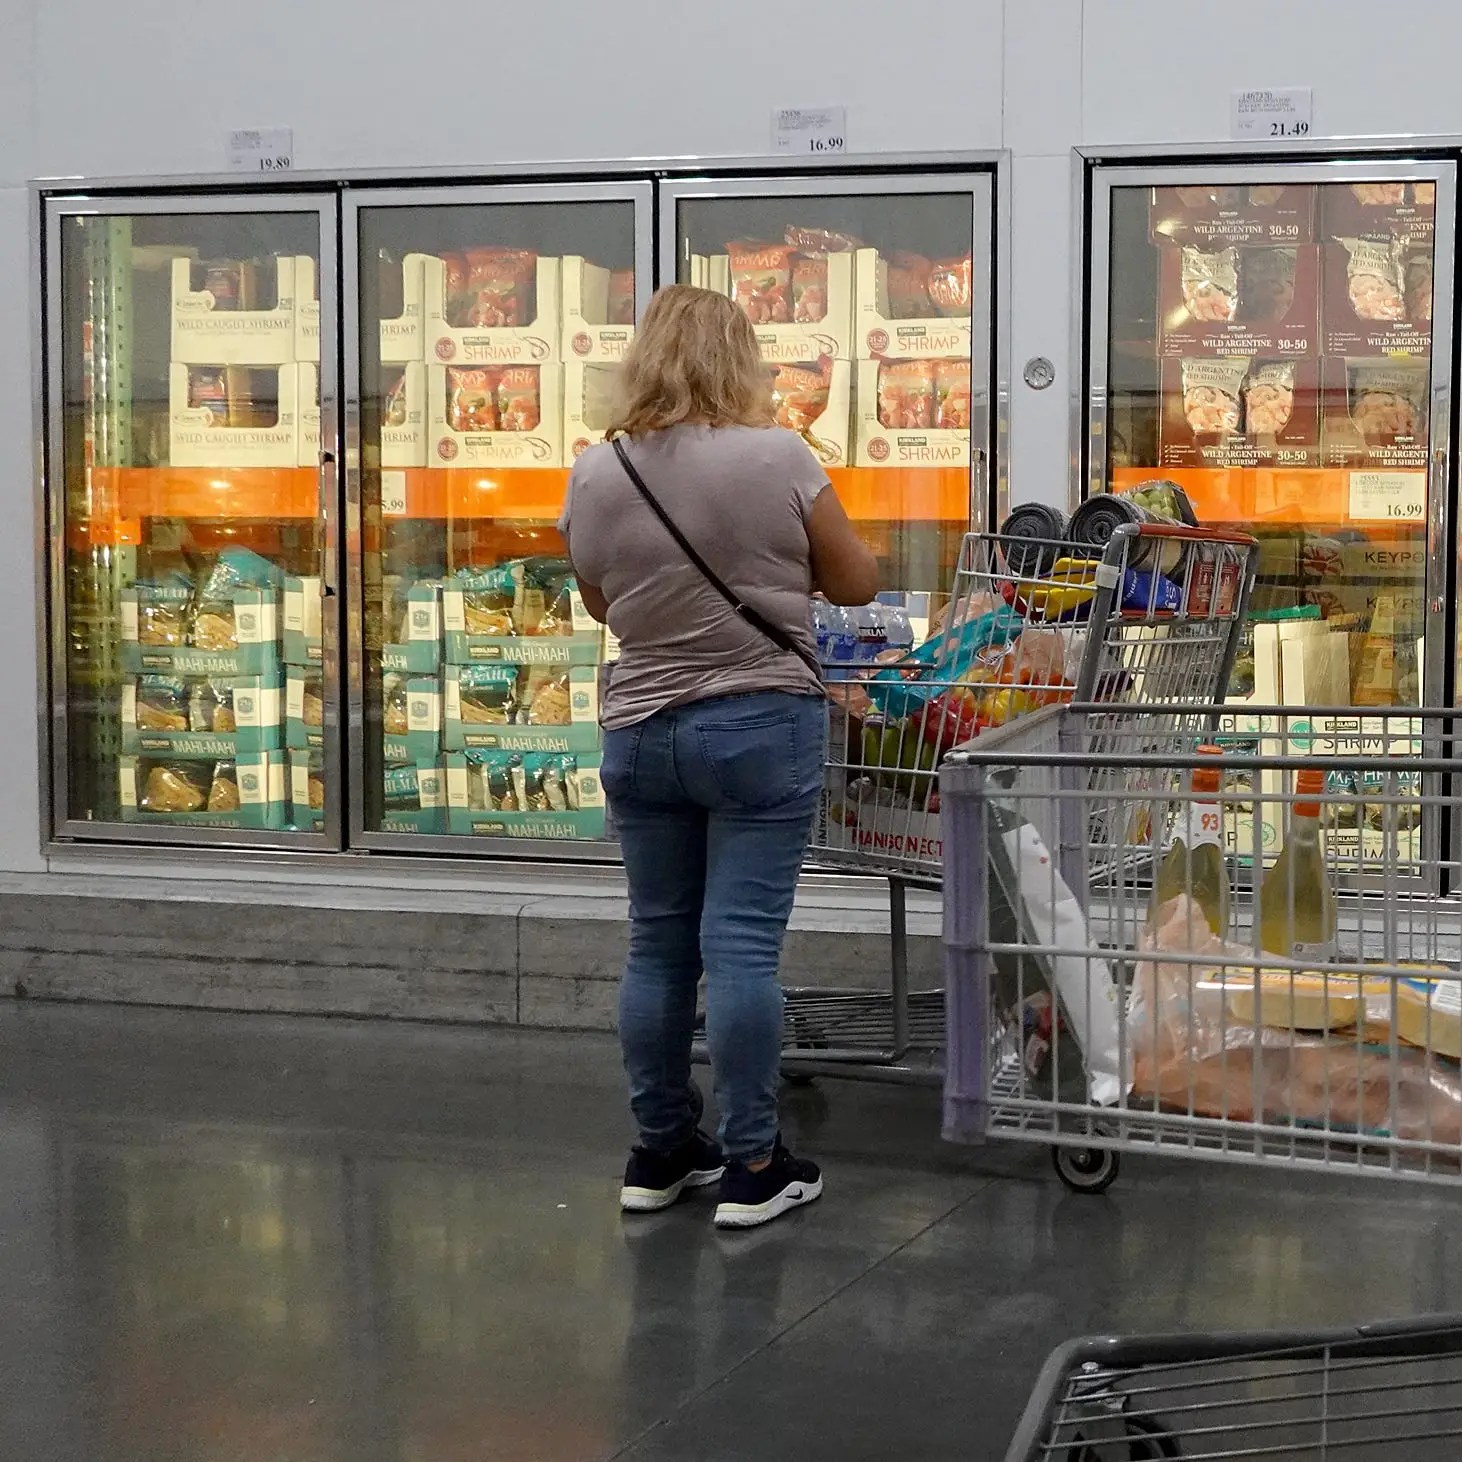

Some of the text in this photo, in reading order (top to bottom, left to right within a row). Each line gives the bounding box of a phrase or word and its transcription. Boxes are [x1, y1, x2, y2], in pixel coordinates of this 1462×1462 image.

[1270, 122, 1309, 136] 21.49
[810, 138, 843, 151] 16.99
[1194, 225, 1263, 234] WILD ARGENTINE
[1269, 225, 1299, 236] 30-50
[1410, 223, 1434, 231] ENTIN
[248, 319, 291, 329] SHRIMP
[381, 325, 417, 336] HRIMP
[899, 336, 960, 351] SHRIMP
[1202, 339, 1272, 348] WILD ARGENTINE
[1278, 339, 1307, 350] 30-50
[1367, 337, 1390, 346] WILD
[1390, 337, 1432, 345] ARGENTIN
[464, 346, 522, 360] SHRIMP
[762, 344, 809, 358] HRIMP
[249, 433, 292, 443] SHRIMP
[383, 432, 419, 443] HRIMP
[467, 447, 523, 460] SHRIMP
[899, 447, 961, 460] SHRIMP
[1202, 450, 1272, 458] WILD ARGENTINE
[1278, 450, 1307, 461] 30-50
[1369, 450, 1429, 458] WILD ARGENTI
[382, 499, 404, 511] 5.99
[1387, 504, 1422, 516] 16.99
[1365, 551, 1425, 563] KEYPO
[503, 648, 570, 662] MAHI-MAHI
[174, 657, 239, 672] MAHI-MAHI
[172, 740, 236, 753] MAHI-MAHI
[501, 736, 569, 750] MAHI-MAHI
[1201, 813, 1219, 831] 93
[507, 823, 576, 837] MAHI-MAHI
[907, 836, 944, 857] NECT
